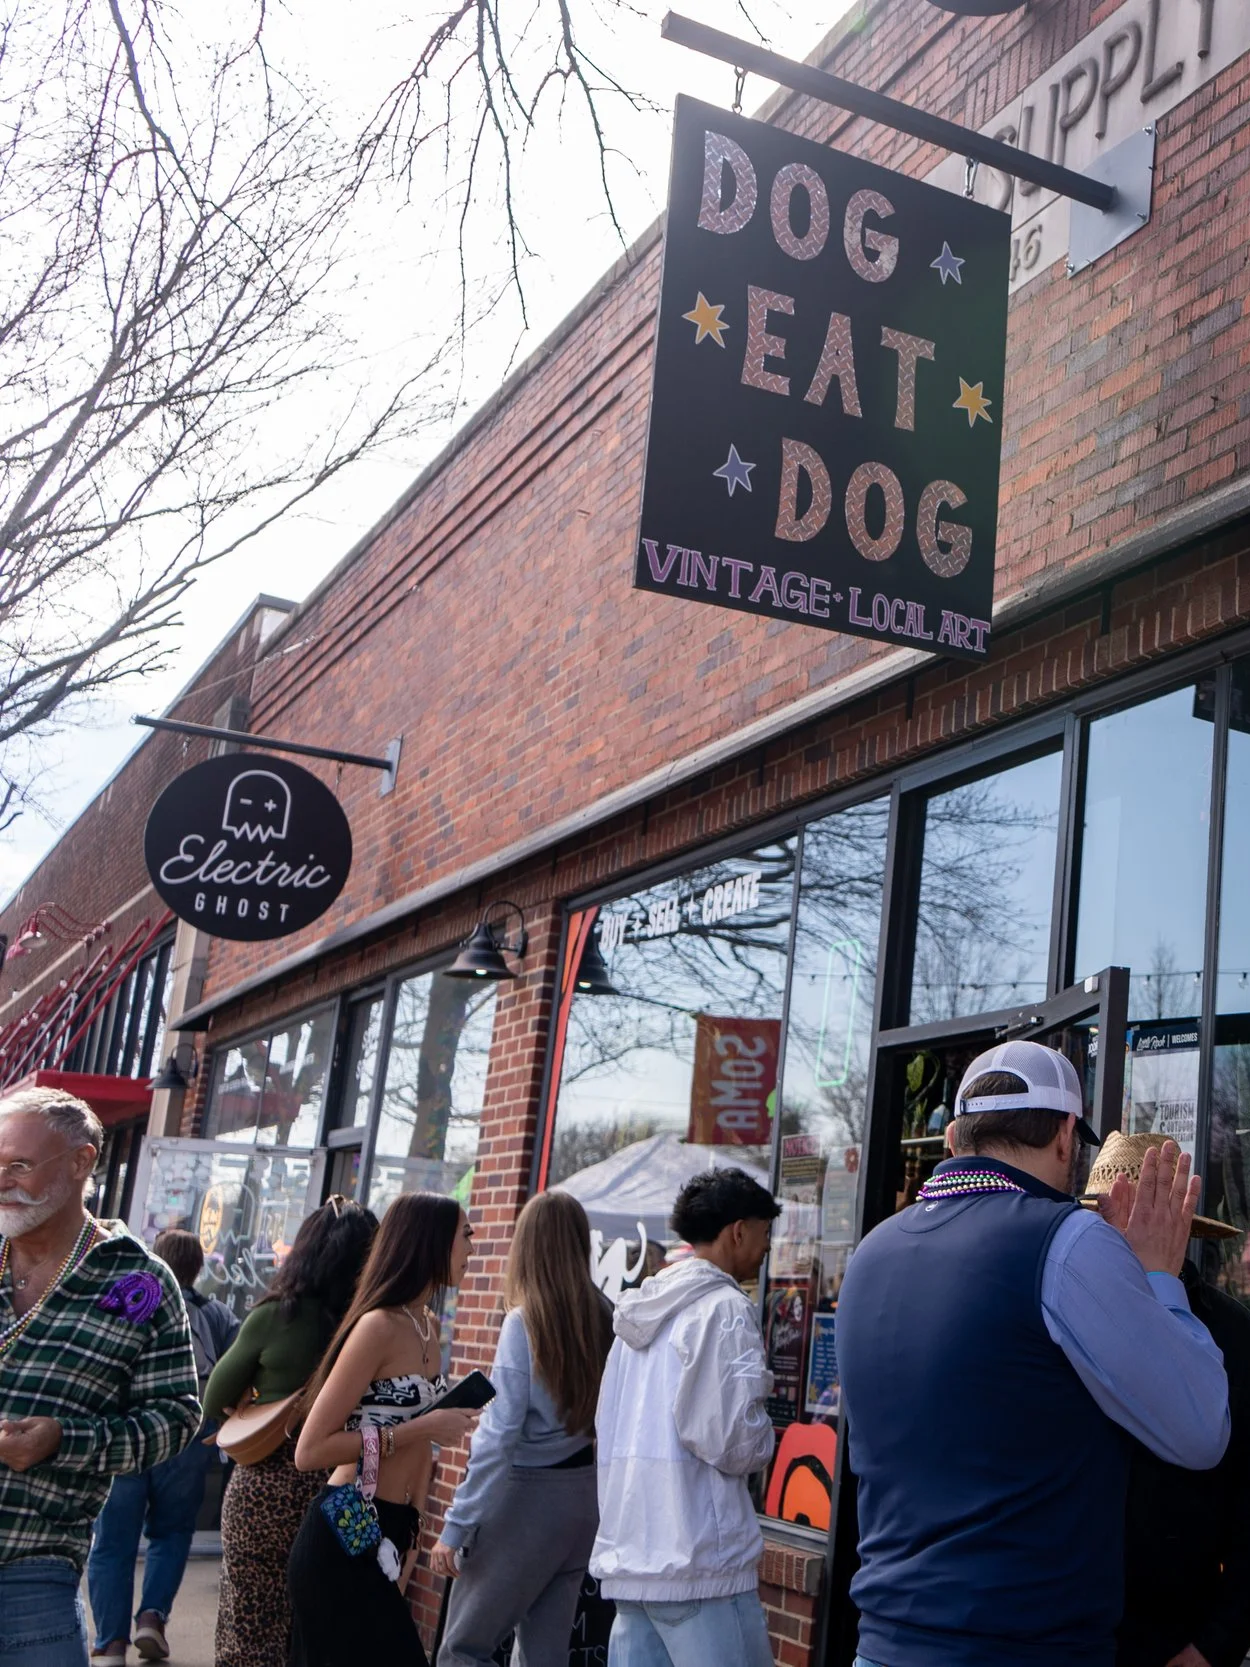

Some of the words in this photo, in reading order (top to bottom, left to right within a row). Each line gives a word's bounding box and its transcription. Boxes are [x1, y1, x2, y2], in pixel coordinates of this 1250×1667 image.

[697, 129, 900, 284] DOG
[740, 284, 935, 432] EAT
[774, 436, 973, 579] DOG
[642, 538, 832, 618] VINTAGE
[848, 586, 934, 640] LOCAL
[937, 609, 992, 654] ART
[159, 833, 332, 889] Electric
[194, 892, 290, 923] GHOST
[599, 913, 628, 952] BUY
[647, 897, 681, 938] SELL
[702, 869, 763, 925] CREATE
[1171, 1032, 1199, 1044] WELCOMES
[1160, 1103, 1195, 1121] TOURISM
